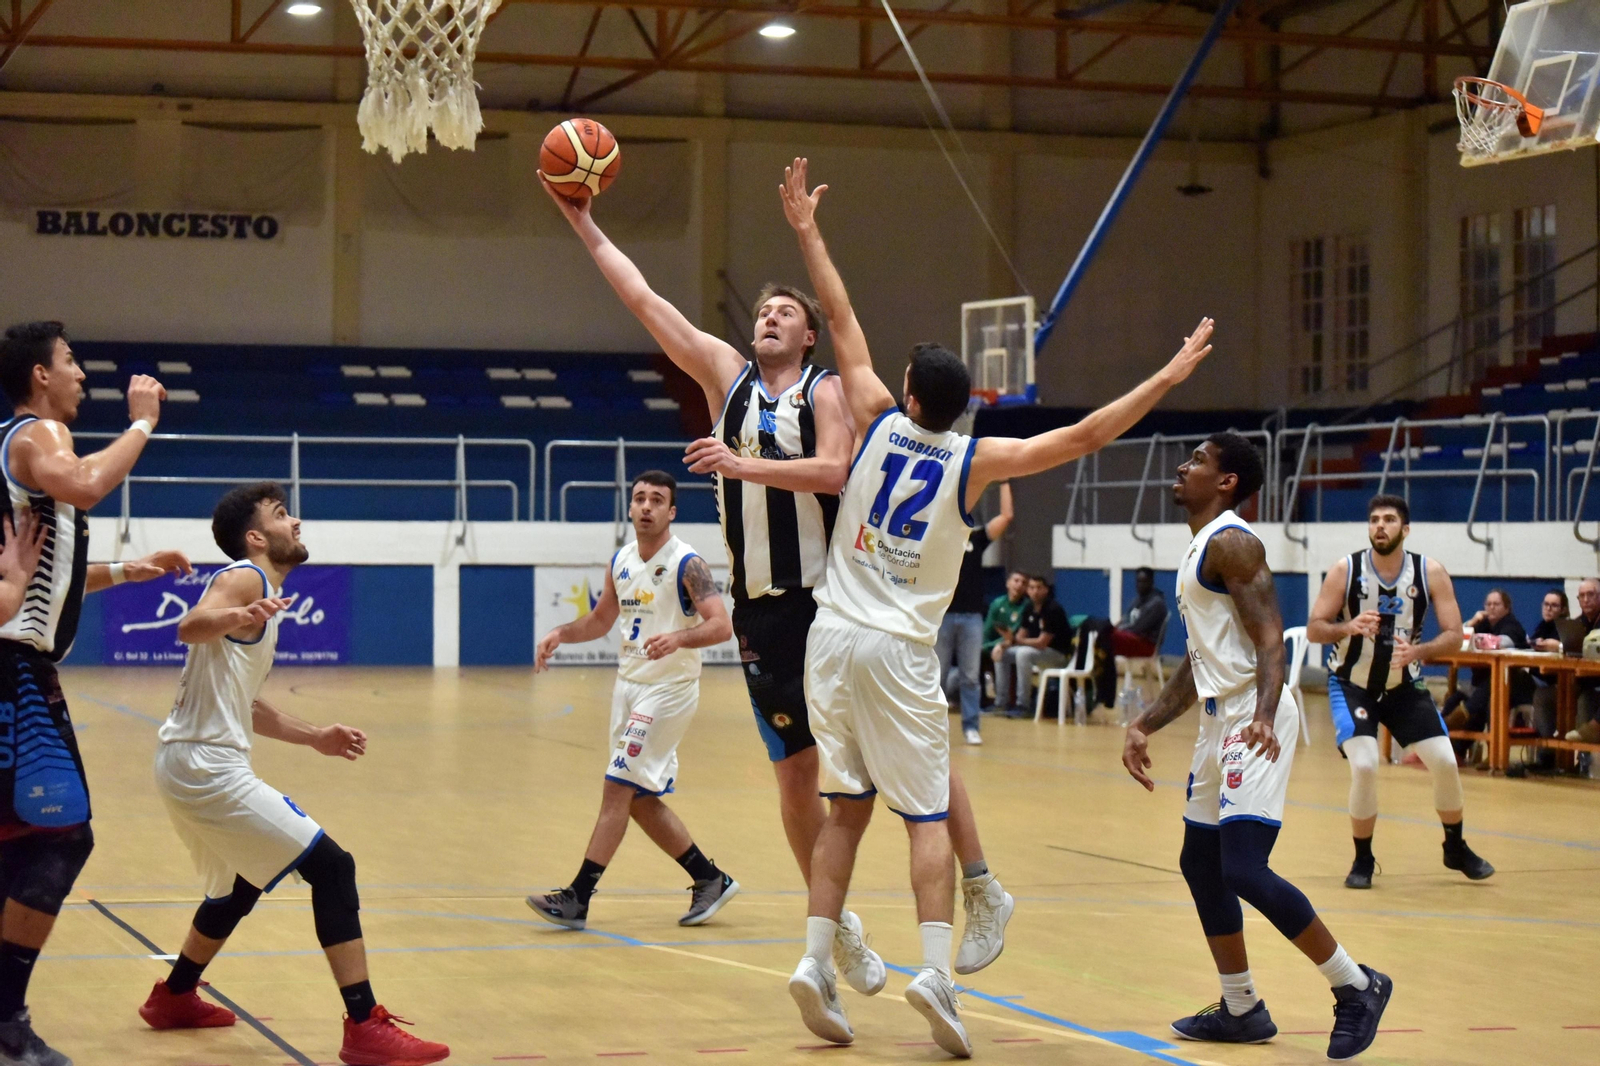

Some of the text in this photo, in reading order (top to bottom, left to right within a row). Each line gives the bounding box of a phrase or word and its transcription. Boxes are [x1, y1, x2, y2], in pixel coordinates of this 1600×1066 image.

[36, 210, 279, 240] BALONCESTO
[867, 452, 943, 541] 12
[1378, 595, 1404, 614] 22
[629, 617, 642, 641] 5
